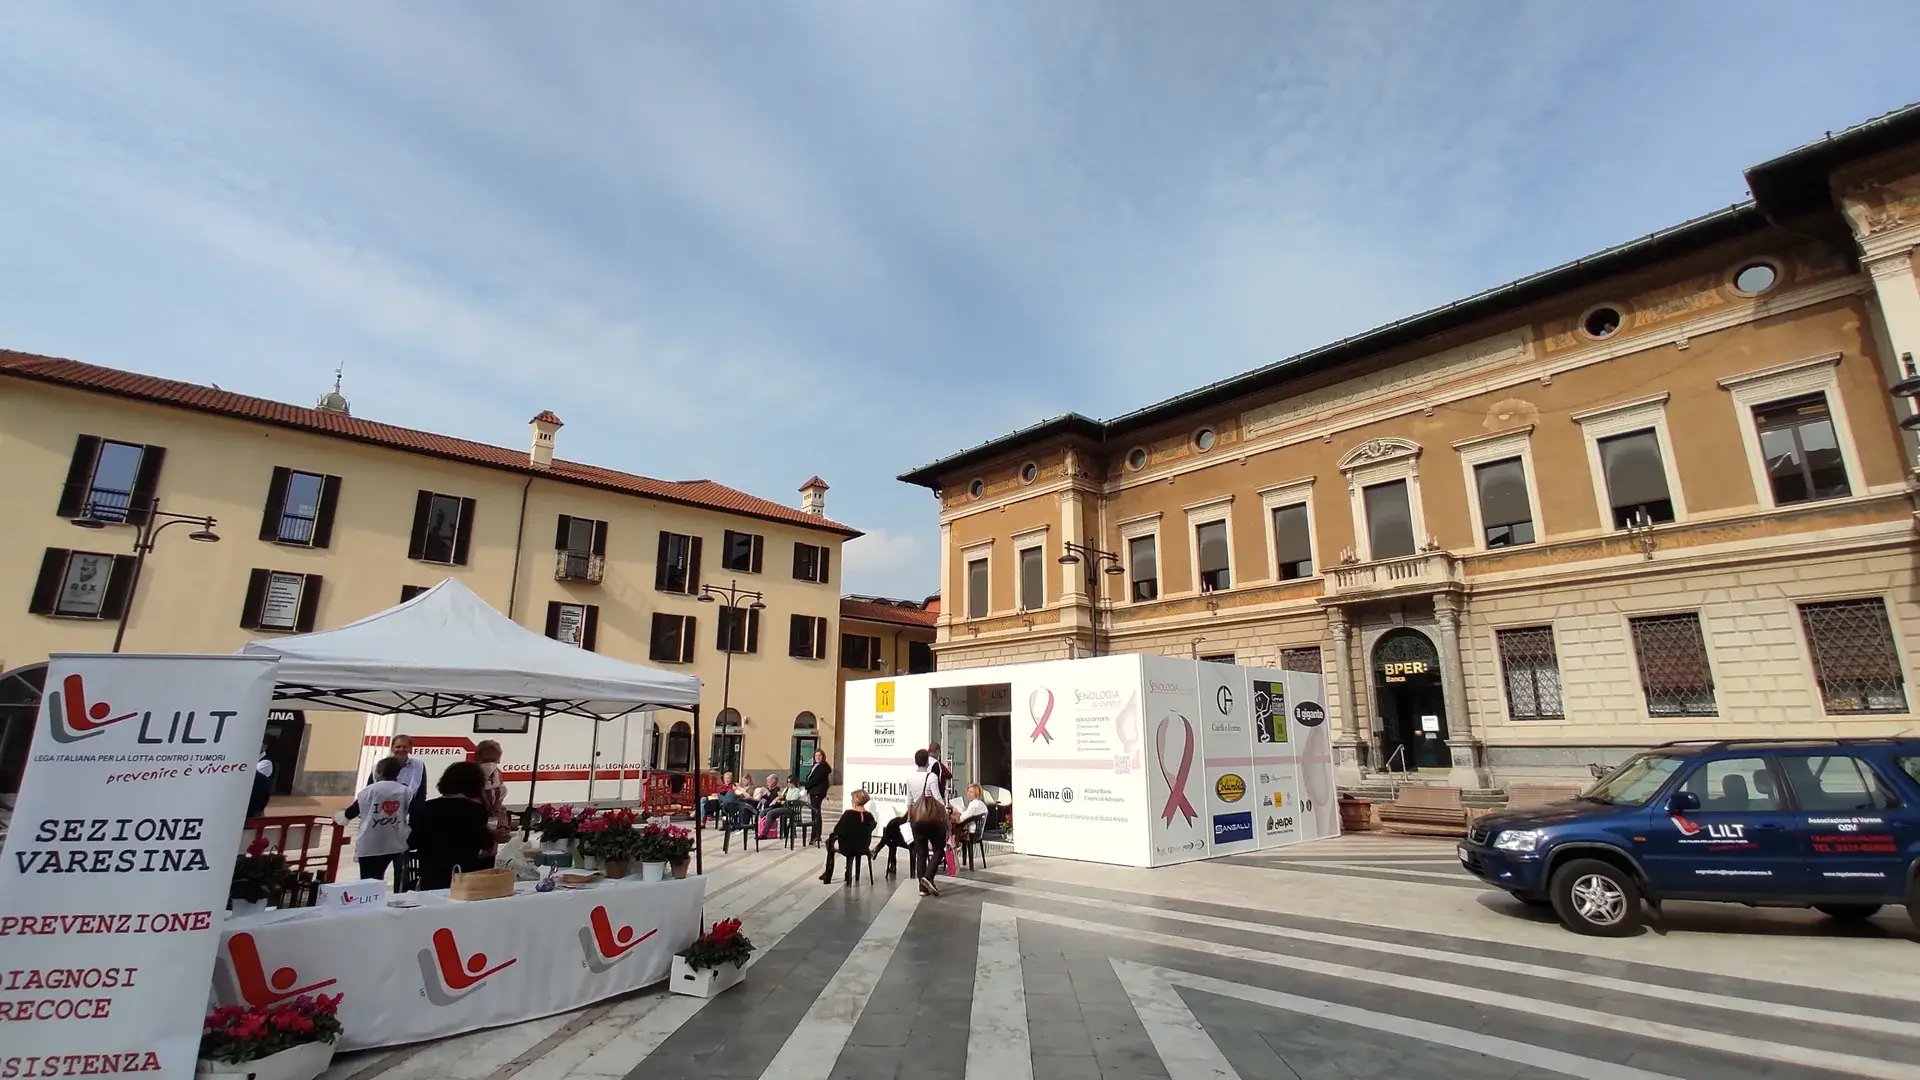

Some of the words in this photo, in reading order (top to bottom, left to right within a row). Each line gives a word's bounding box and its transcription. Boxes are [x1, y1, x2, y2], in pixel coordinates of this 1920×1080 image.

[70, 583, 98, 591] REX
[1075, 689, 1120, 705] SENOLOGIA
[137, 710, 238, 743] LILT
[127, 754, 154, 762] LOTTA
[156, 754, 189, 762] CONTRO
[409, 747, 461, 755] FERMERIA
[106, 767, 179, 784] prevenire
[183, 764, 192, 777] è
[198, 762, 248, 775] vivere
[862, 781, 907, 796] FUJIFILM
[1028, 788, 1060, 799] Allianz
[374, 803, 379, 814] I
[35, 818, 204, 842] SEZIONE
[1215, 822, 1250, 835] SANGALLI
[1708, 824, 1744, 838] LILT
[1837, 823, 1858, 831] ODV
[15, 849, 211, 873] VARESINA
[360, 894, 379, 904] LILT
[0, 911, 212, 936] PREVENZIONE
[0, 968, 138, 990] IAGNOSI
[0, 1051, 162, 1079] SISTENZA
